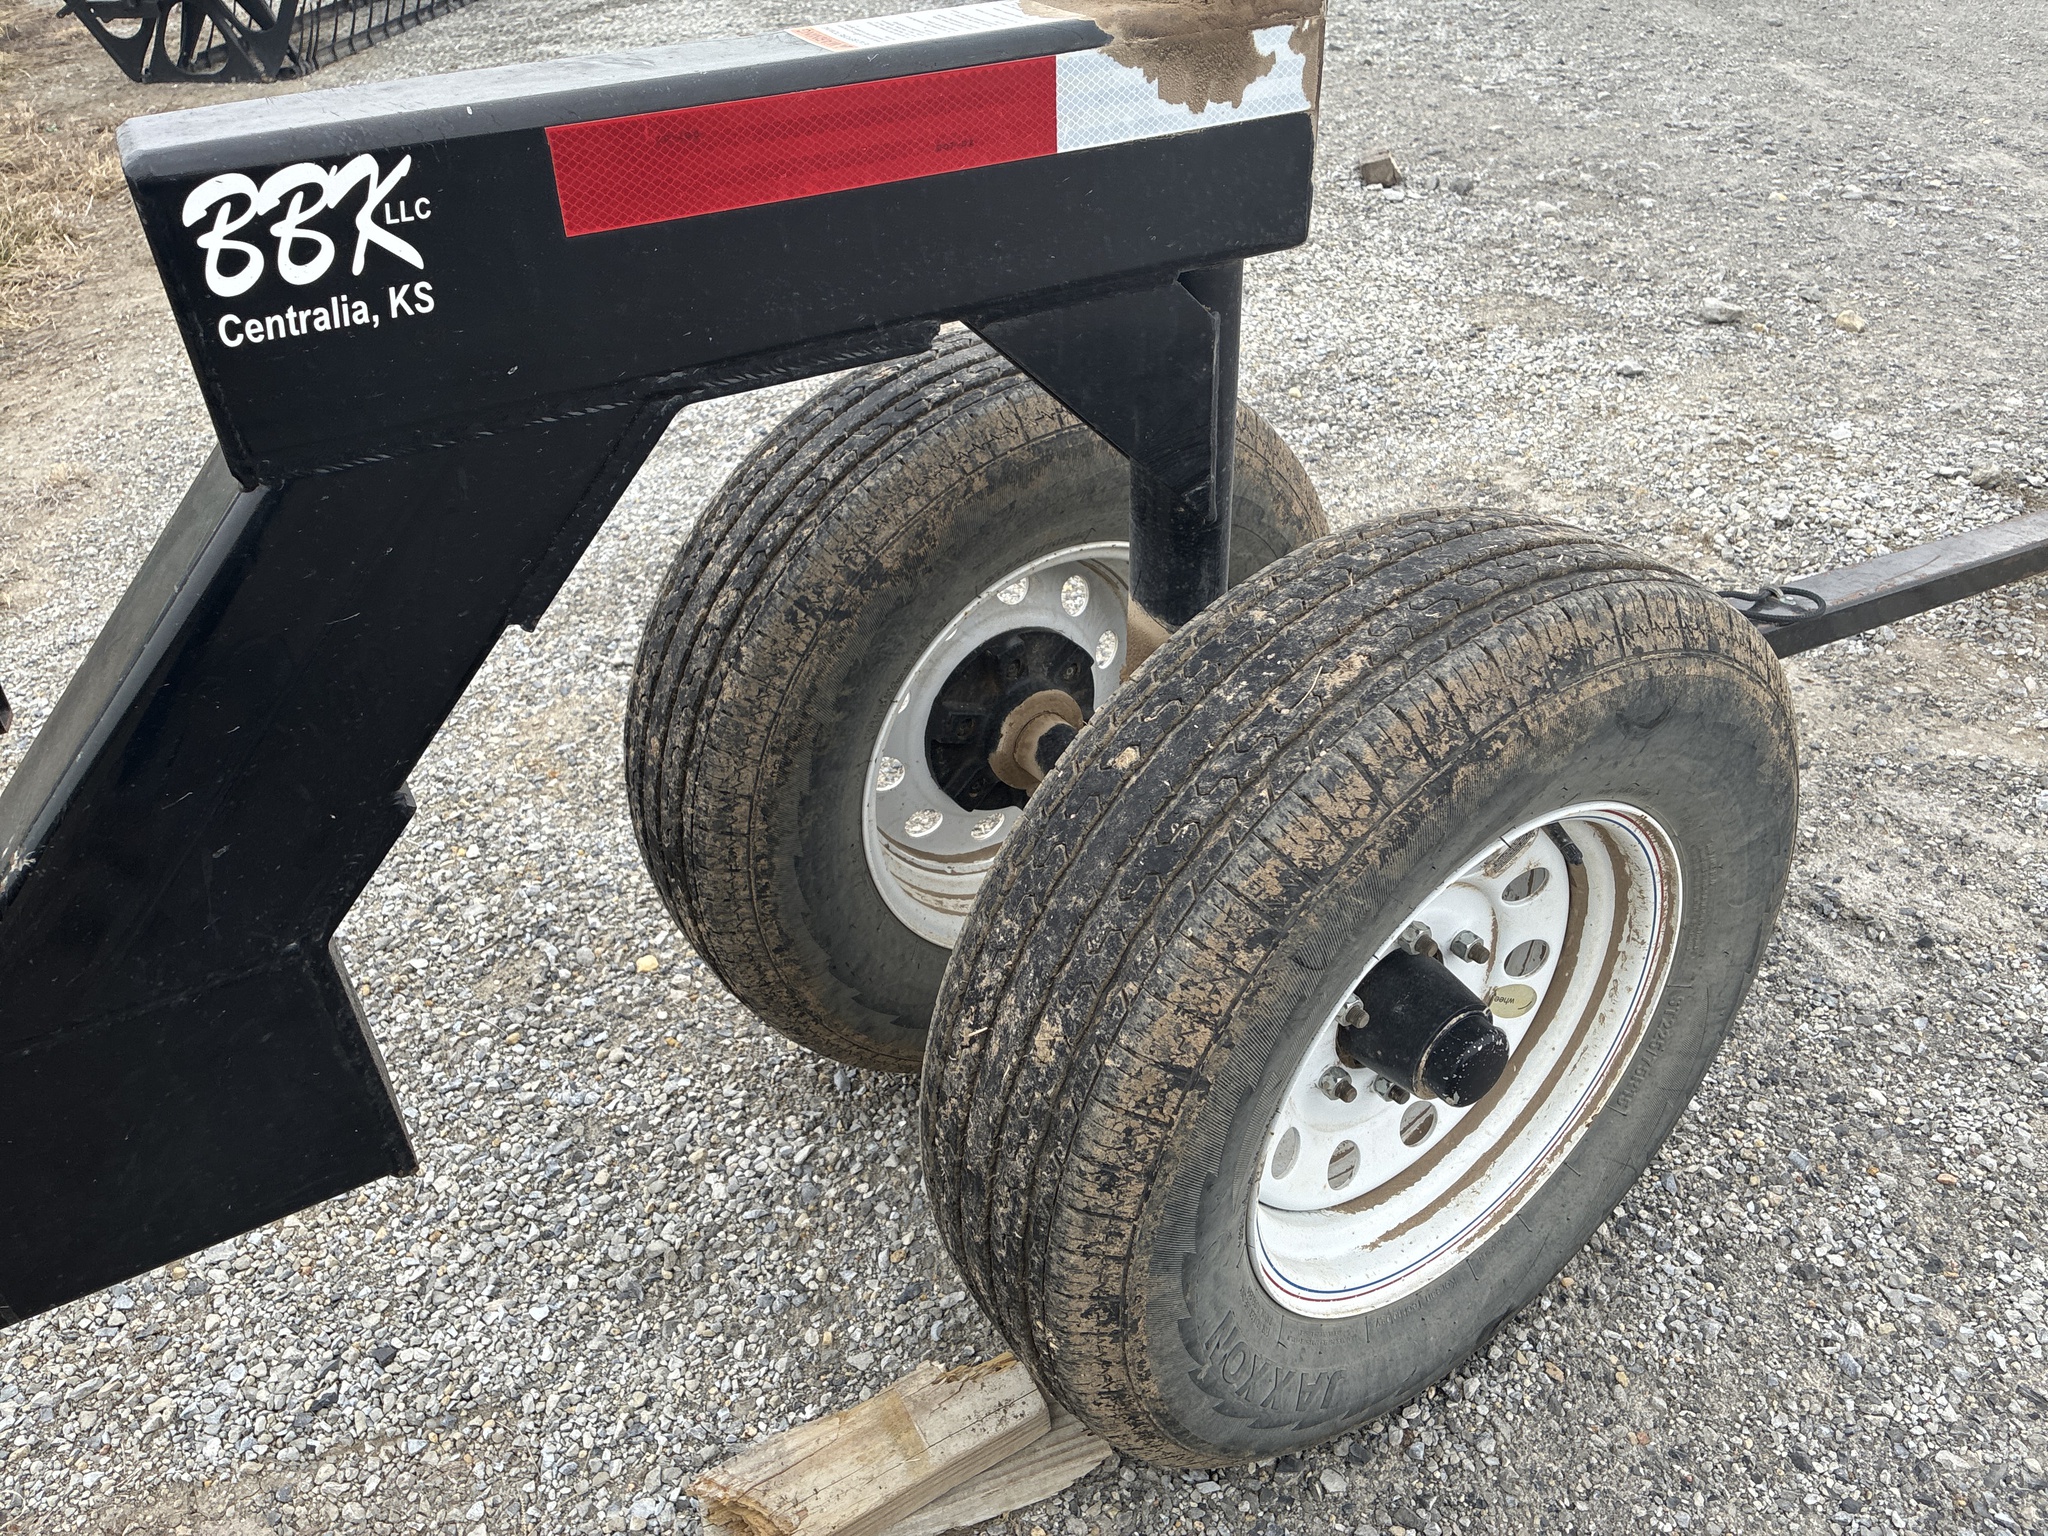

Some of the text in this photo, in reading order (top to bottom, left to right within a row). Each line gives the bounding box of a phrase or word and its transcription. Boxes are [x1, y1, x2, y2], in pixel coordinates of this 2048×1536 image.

[182, 153, 432, 297] BBK LLC
[218, 281, 435, 348] Centralia, KS
[1492, 996, 1515, 1005] whee
[1205, 1310, 1346, 1411] JAXXON
